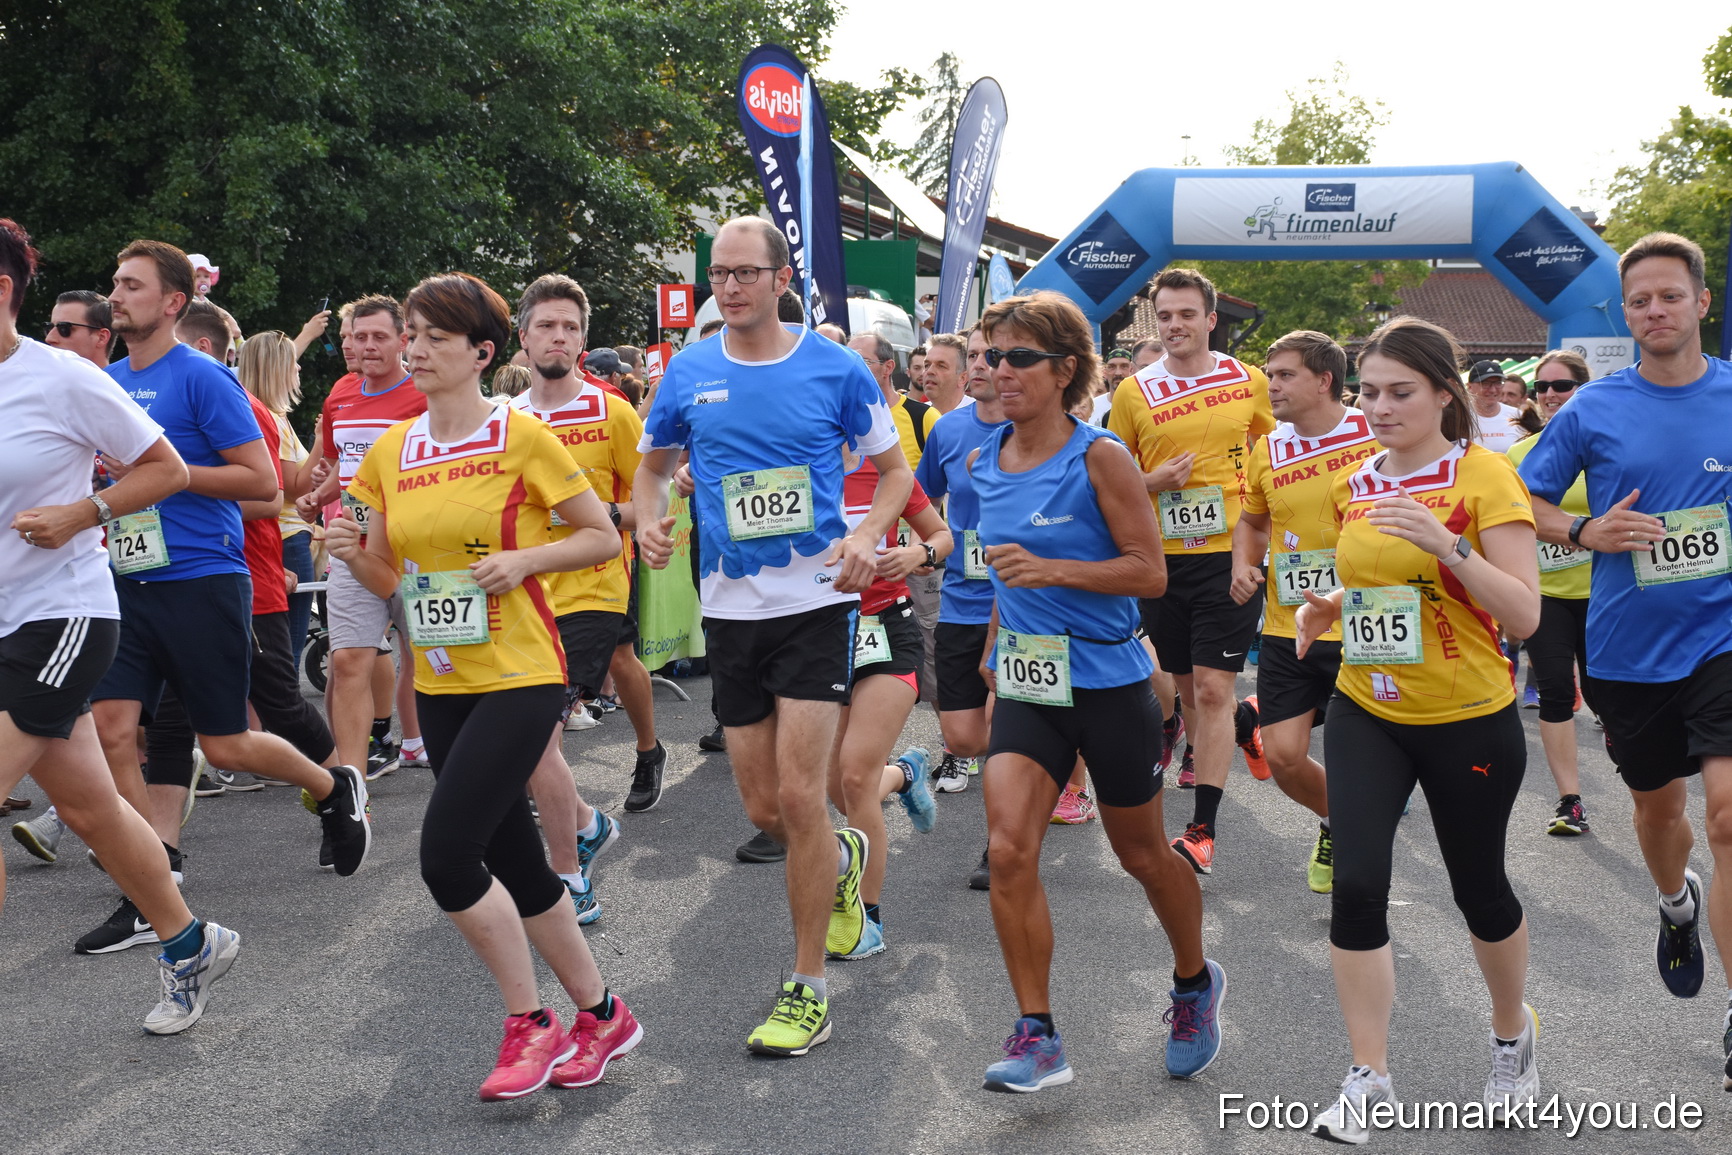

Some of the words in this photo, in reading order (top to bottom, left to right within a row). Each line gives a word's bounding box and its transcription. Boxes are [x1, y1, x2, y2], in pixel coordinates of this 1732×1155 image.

[976, 117, 996, 200] AUTOMOBILE
[1316, 194, 1352, 202] Fischer
[1286, 213, 1398, 232] firmenlauf
[1079, 251, 1136, 263] Fischer
[1533, 246, 1550, 255] das
[136, 388, 157, 399] beim
[1152, 400, 1199, 426] MAX
[1203, 387, 1253, 408] BÖGL
[344, 442, 375, 453] Pet
[558, 428, 610, 447] BÖGL
[397, 471, 440, 493] MAX
[448, 460, 505, 482] BÖGL
[1272, 464, 1320, 489] MAX
[735, 490, 801, 520] 1082
[1168, 504, 1217, 525] 1614
[1344, 506, 1372, 524] MA
[1415, 495, 1450, 510] ÖGL
[766, 516, 793, 524] Thomas
[1706, 522, 1723, 531] 2019
[115, 533, 147, 558] 724
[1541, 544, 1572, 560] 128
[1648, 531, 1719, 565] 1068
[1655, 562, 1685, 573] Göpfert
[1687, 558, 1714, 567] Helmut
[1285, 568, 1336, 590] 1571
[414, 597, 473, 625] 1597
[1349, 615, 1408, 643] 1615
[856, 632, 879, 652] 24
[1379, 644, 1395, 652] Katja
[1003, 656, 1058, 686] 1063
